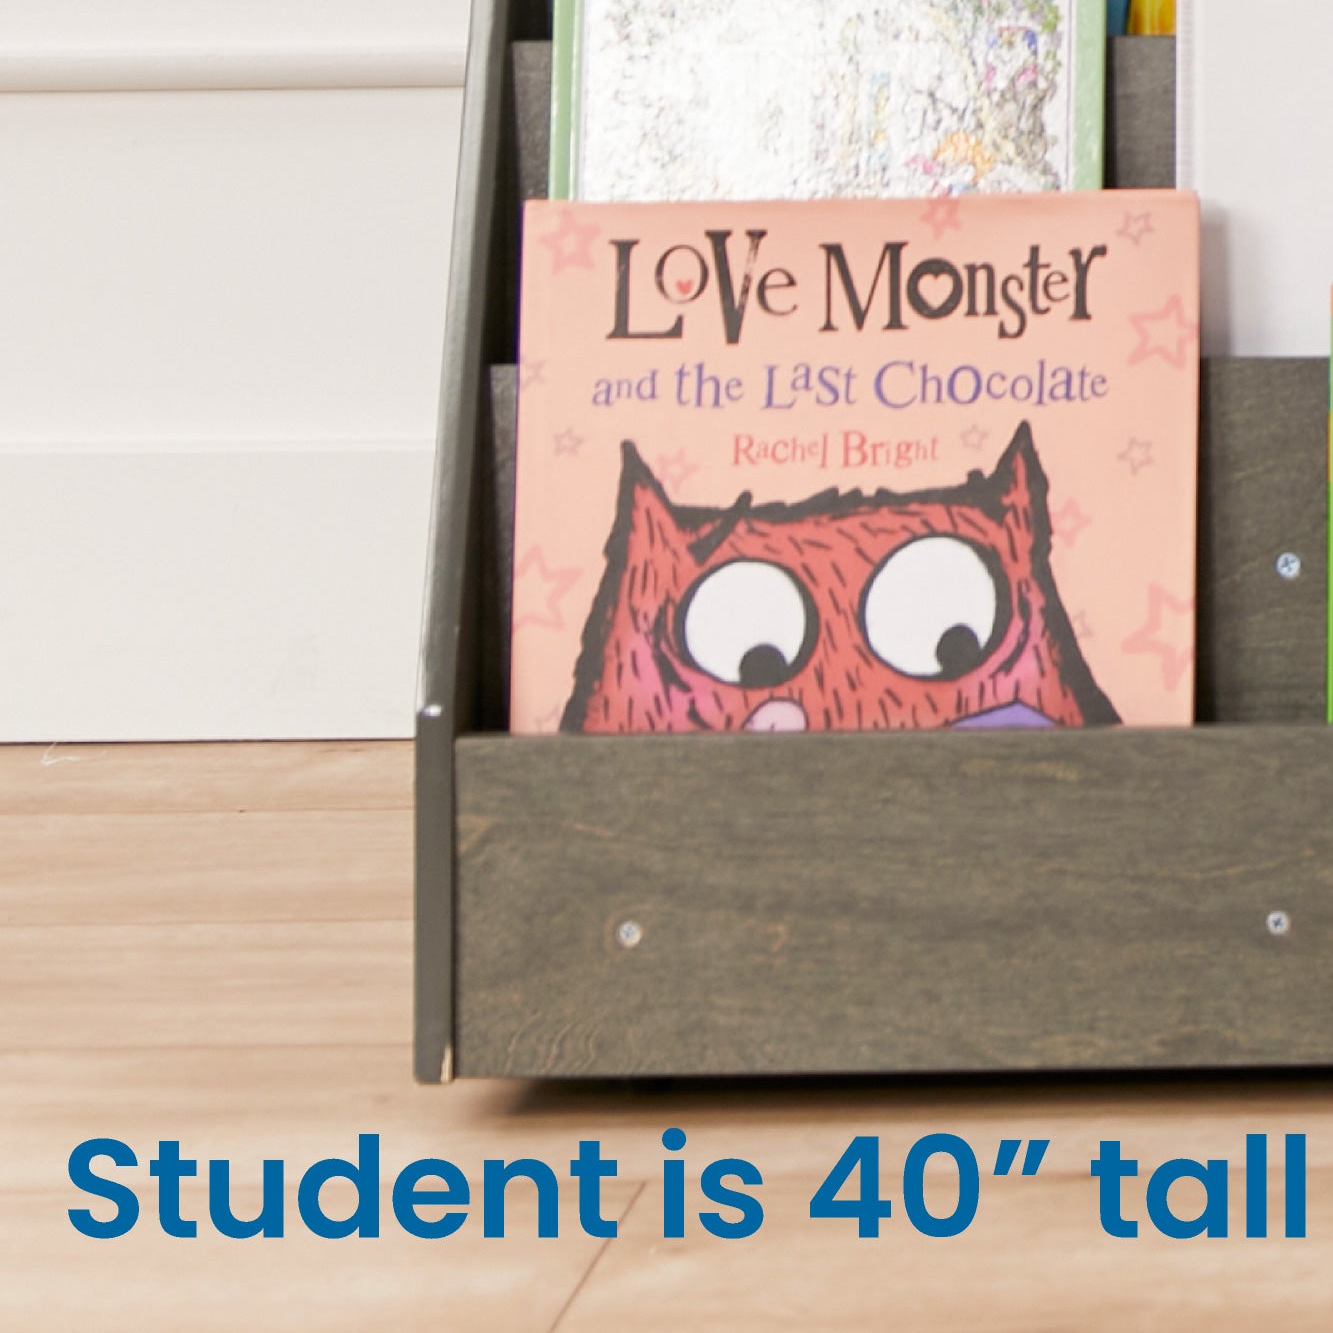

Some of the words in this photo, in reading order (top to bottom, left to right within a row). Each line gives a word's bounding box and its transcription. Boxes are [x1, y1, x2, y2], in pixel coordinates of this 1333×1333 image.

[818, 240, 1108, 340] Monster
[591, 368, 659, 406] and
[675, 362, 743, 408] the
[731, 433, 829, 469] Rachel
[842, 431, 939, 469] Bright
